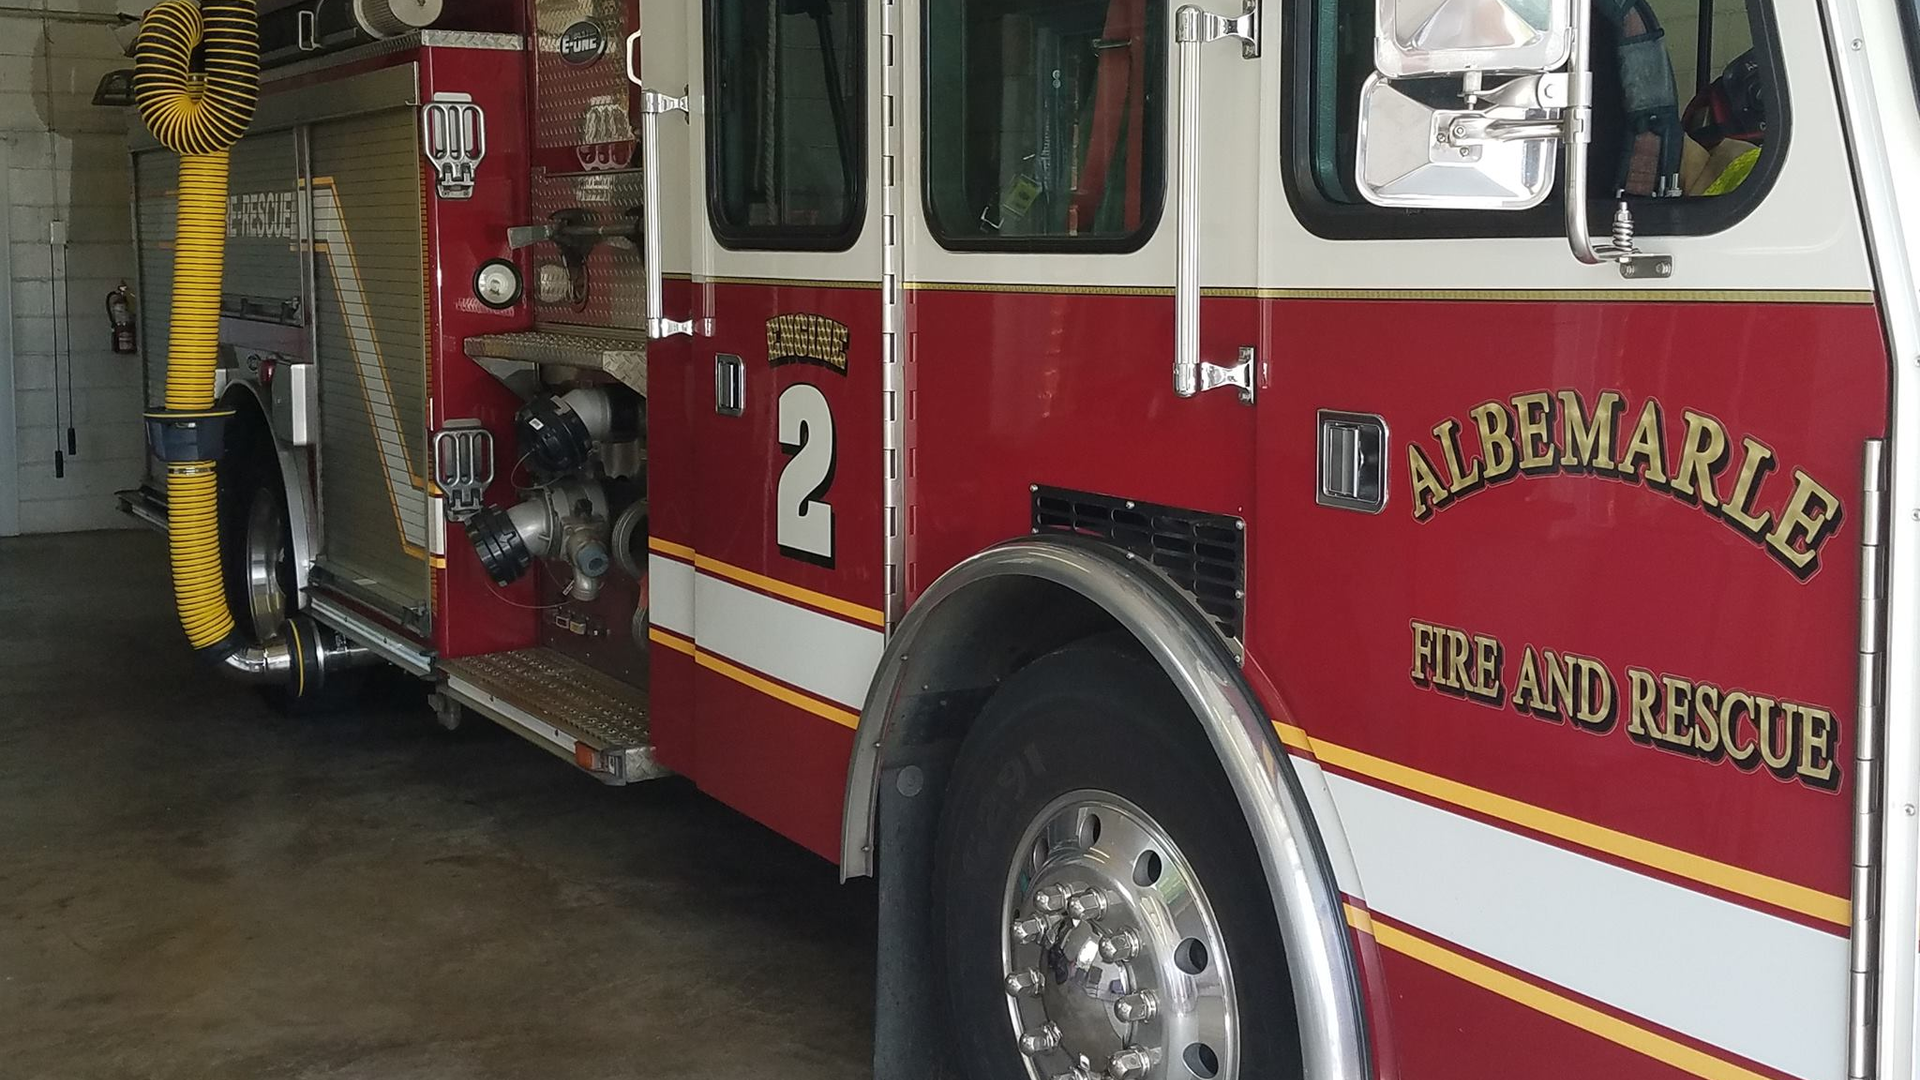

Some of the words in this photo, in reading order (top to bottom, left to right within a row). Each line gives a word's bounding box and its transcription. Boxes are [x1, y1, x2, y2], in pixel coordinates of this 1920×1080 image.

[562, 35, 598, 55] E-ONE
[766, 314, 848, 373] ENGINE
[777, 383, 835, 568] 2
[1406, 390, 1842, 577] ALBEMARLE
[1411, 621, 1503, 704] FIRE
[1513, 647, 1615, 734] AND
[1628, 668, 1838, 790] RESCUE
